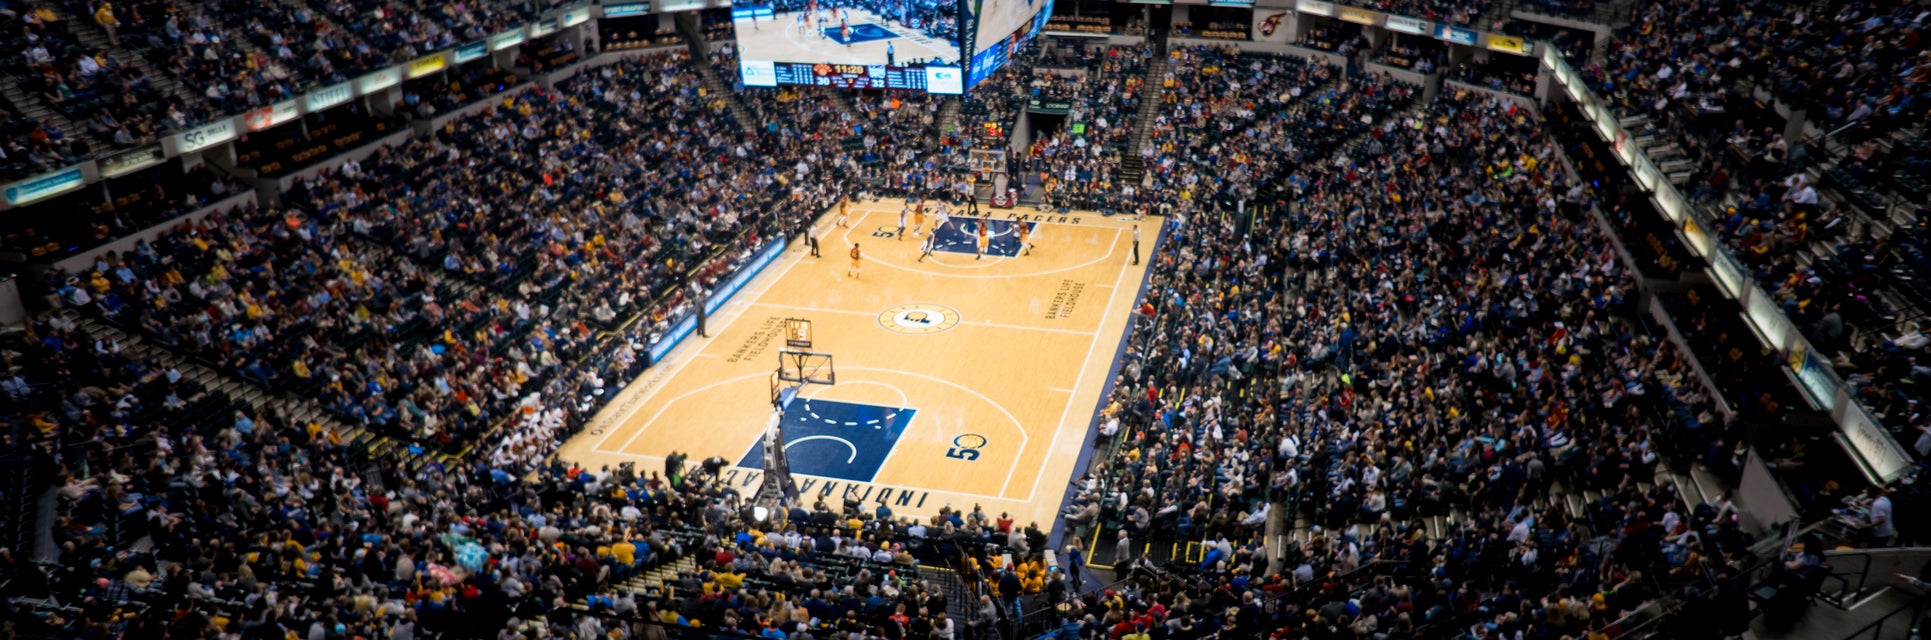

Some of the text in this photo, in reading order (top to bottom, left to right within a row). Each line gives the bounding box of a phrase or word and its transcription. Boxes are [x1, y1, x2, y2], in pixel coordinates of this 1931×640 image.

[816, 76, 830, 85] 30
[834, 65, 863, 74] 11:20
[871, 78, 885, 87] 32
[184, 131, 205, 149] SG
[1007, 212, 1082, 224] PACERS
[1044, 279, 1074, 319] BANKERS LIFE
[1059, 282, 1085, 318] FIELDHOUSE
[726, 316, 780, 362] BANKERS LIFE
[945, 433, 987, 461] 50
[799, 478, 929, 509] INDIANA
